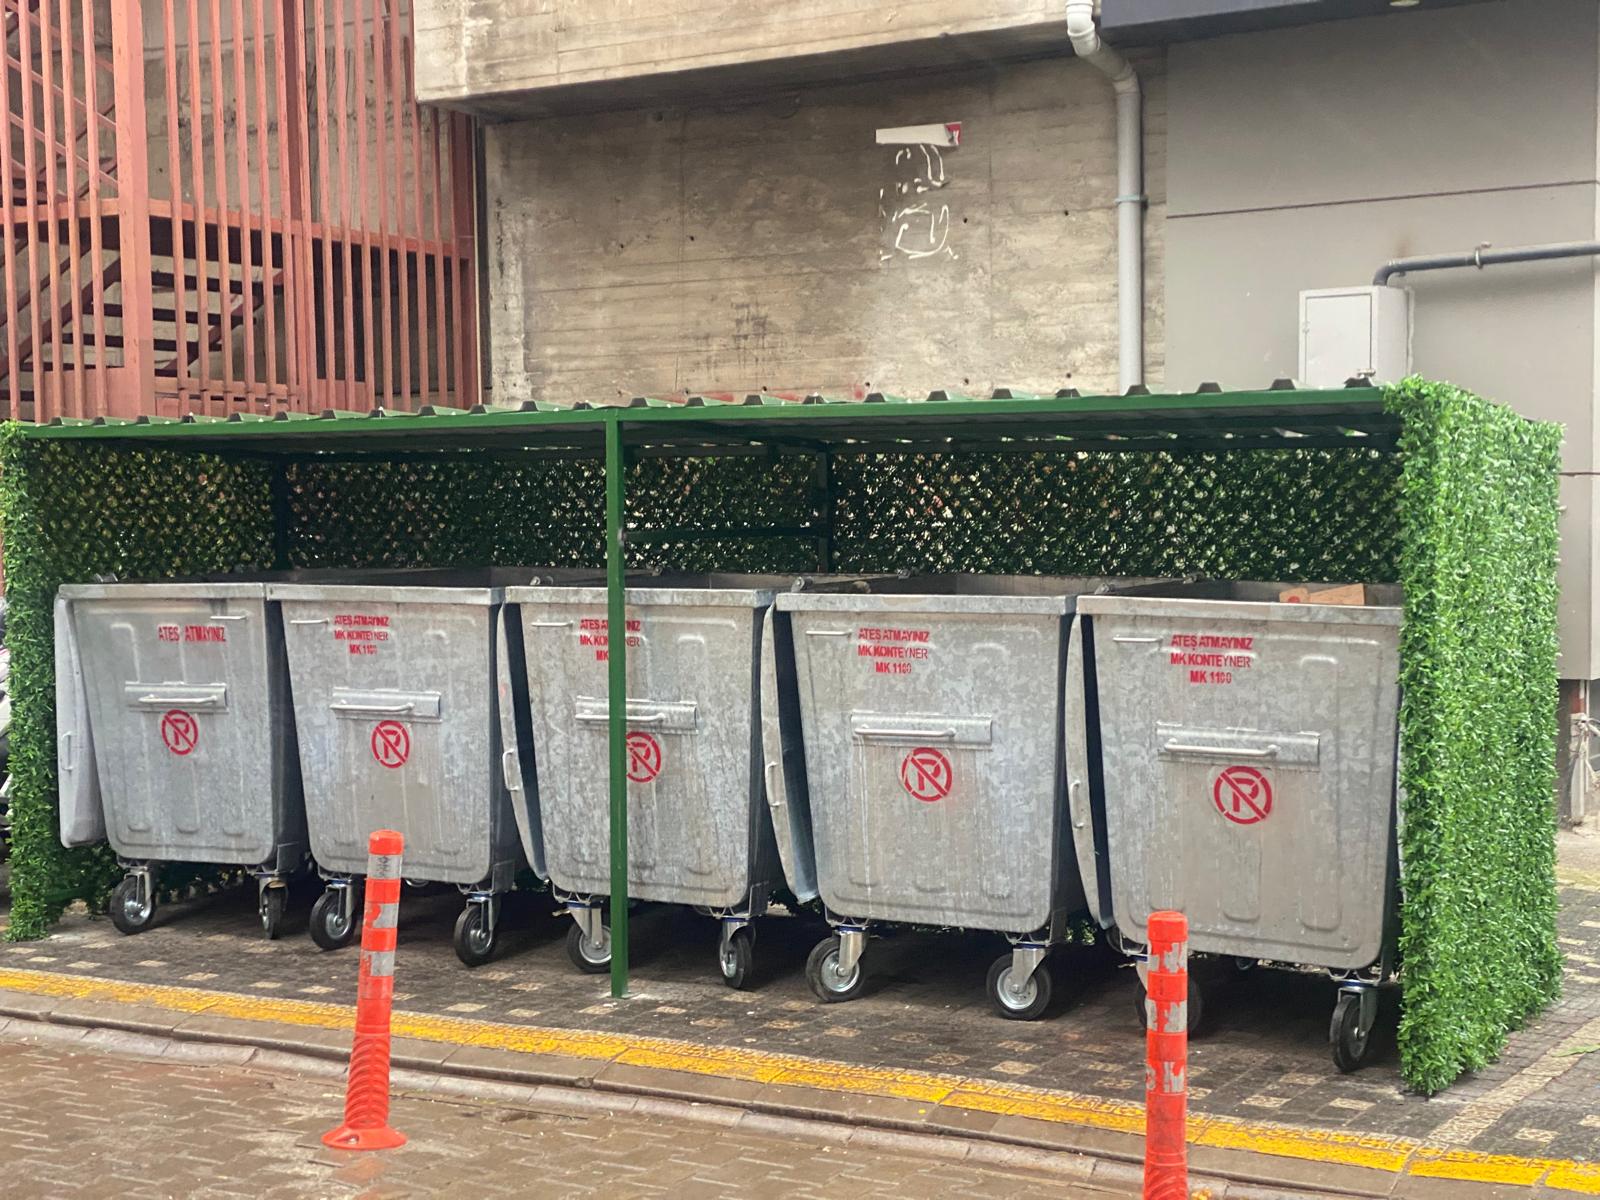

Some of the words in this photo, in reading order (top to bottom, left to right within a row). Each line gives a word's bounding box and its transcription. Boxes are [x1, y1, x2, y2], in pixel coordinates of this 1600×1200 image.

[347, 631, 389, 641] KONTENER
[882, 629, 930, 643] ATMAYINIZ
[1199, 636, 1253, 650] ATMAYINIZ
[858, 645, 872, 656] MK
[873, 646, 928, 659] KONTEYNER
[875, 662, 890, 673] MK
[1170, 653, 1186, 665] MK
[1188, 654, 1251, 668] KONTEYNER
[1189, 671, 1207, 683] MK
